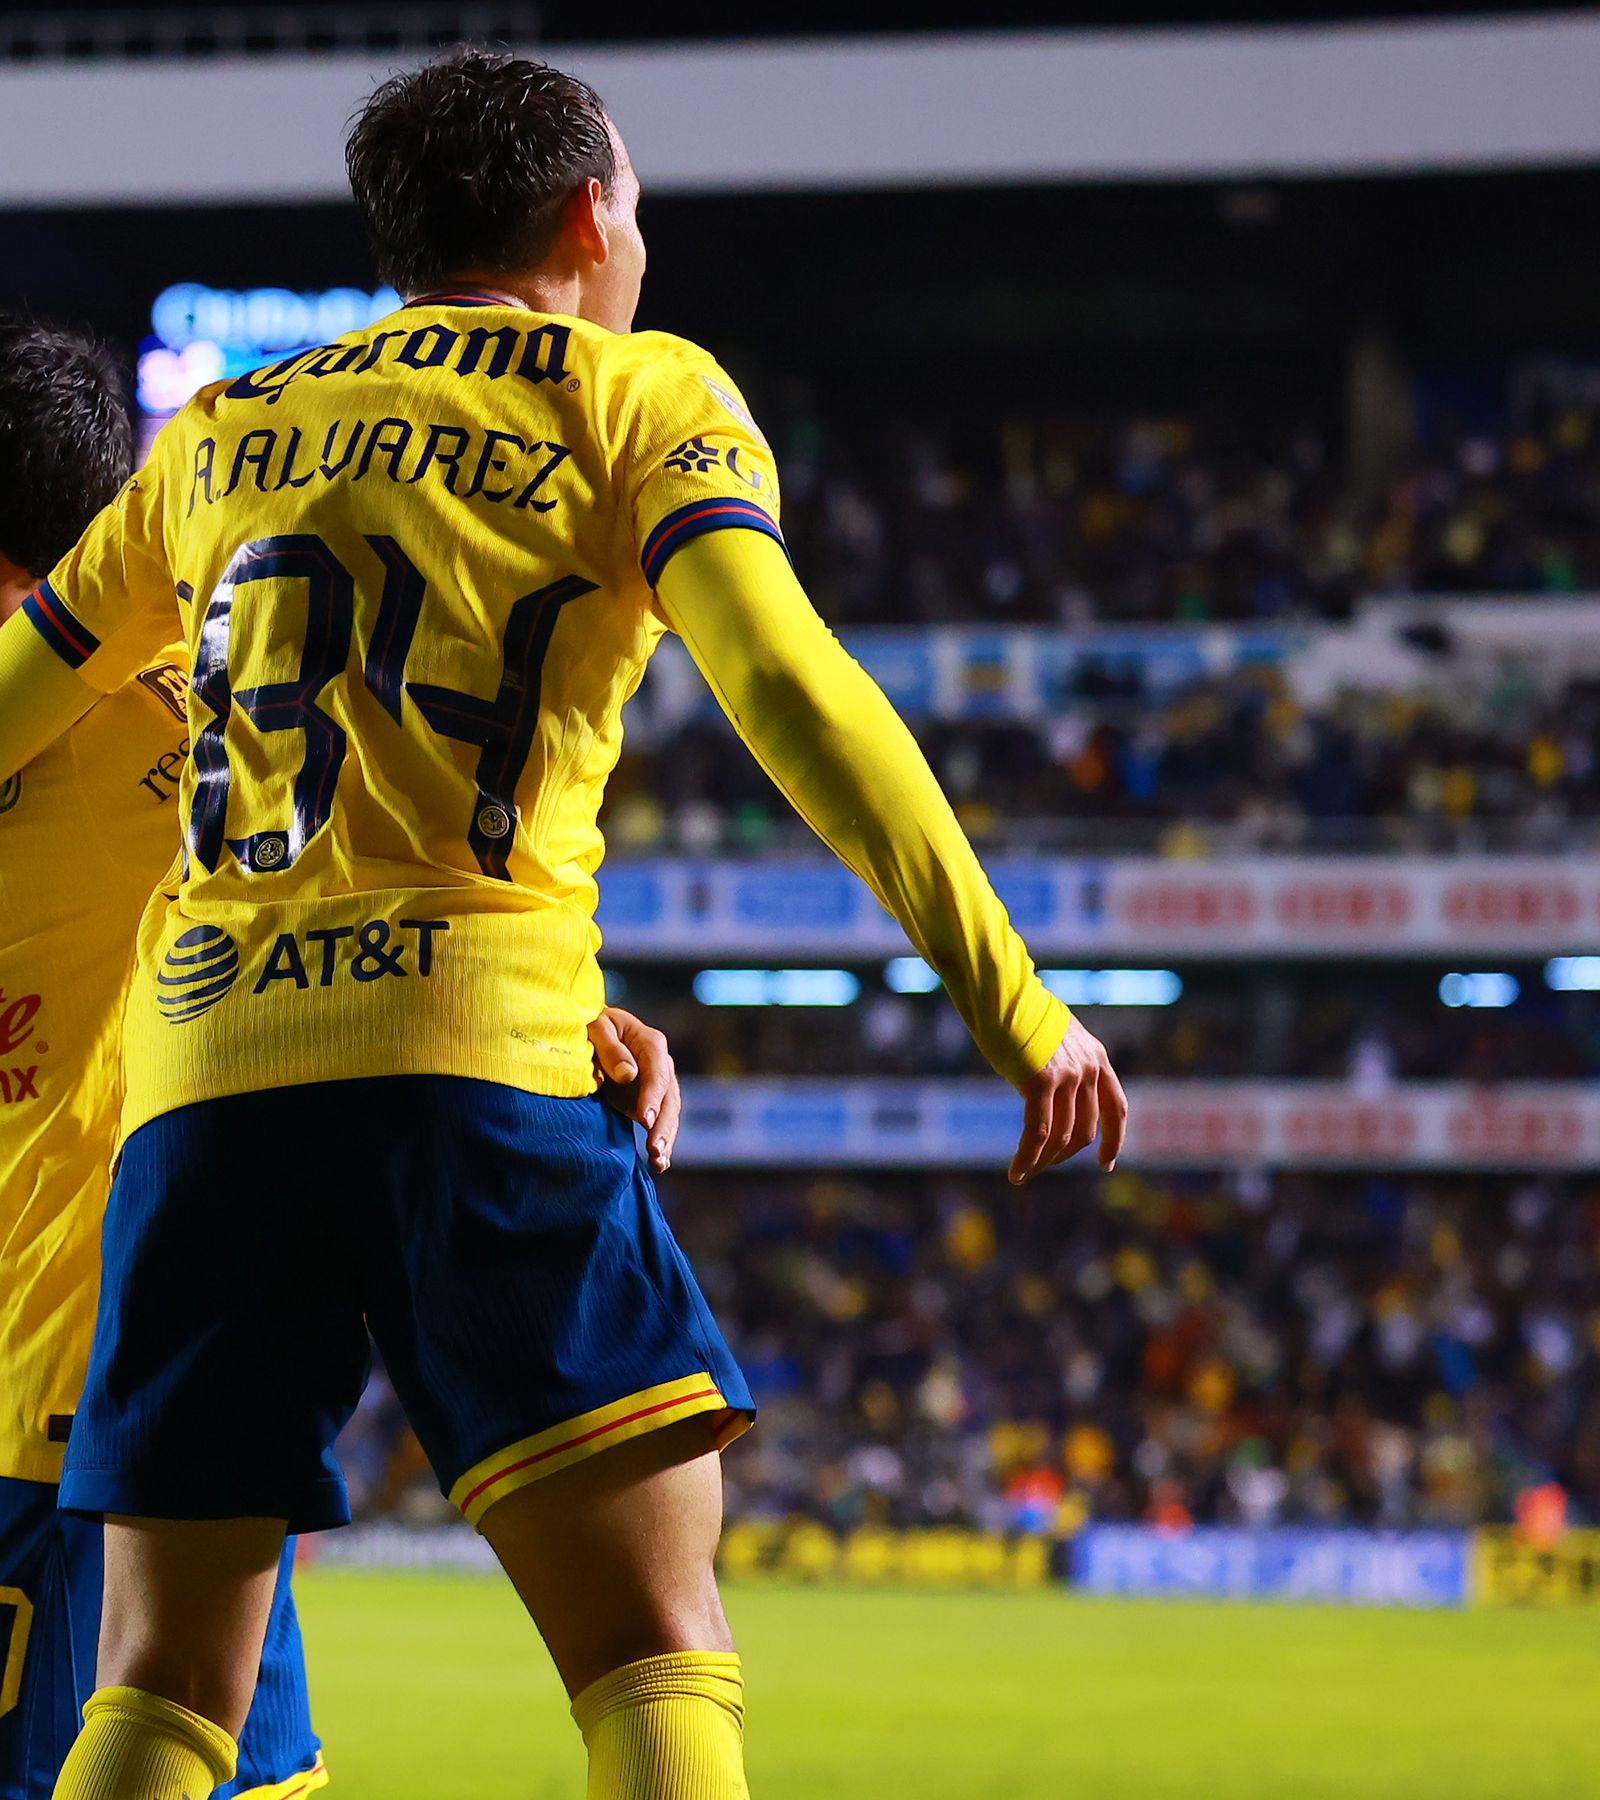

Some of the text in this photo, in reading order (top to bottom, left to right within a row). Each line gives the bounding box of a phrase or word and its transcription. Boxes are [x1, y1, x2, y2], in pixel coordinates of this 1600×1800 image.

[224, 322, 572, 405] Corona
[186, 416, 573, 518] A.ALVAREZ
[176, 533, 601, 884] 84
[252, 919, 450, 995] AT&T
